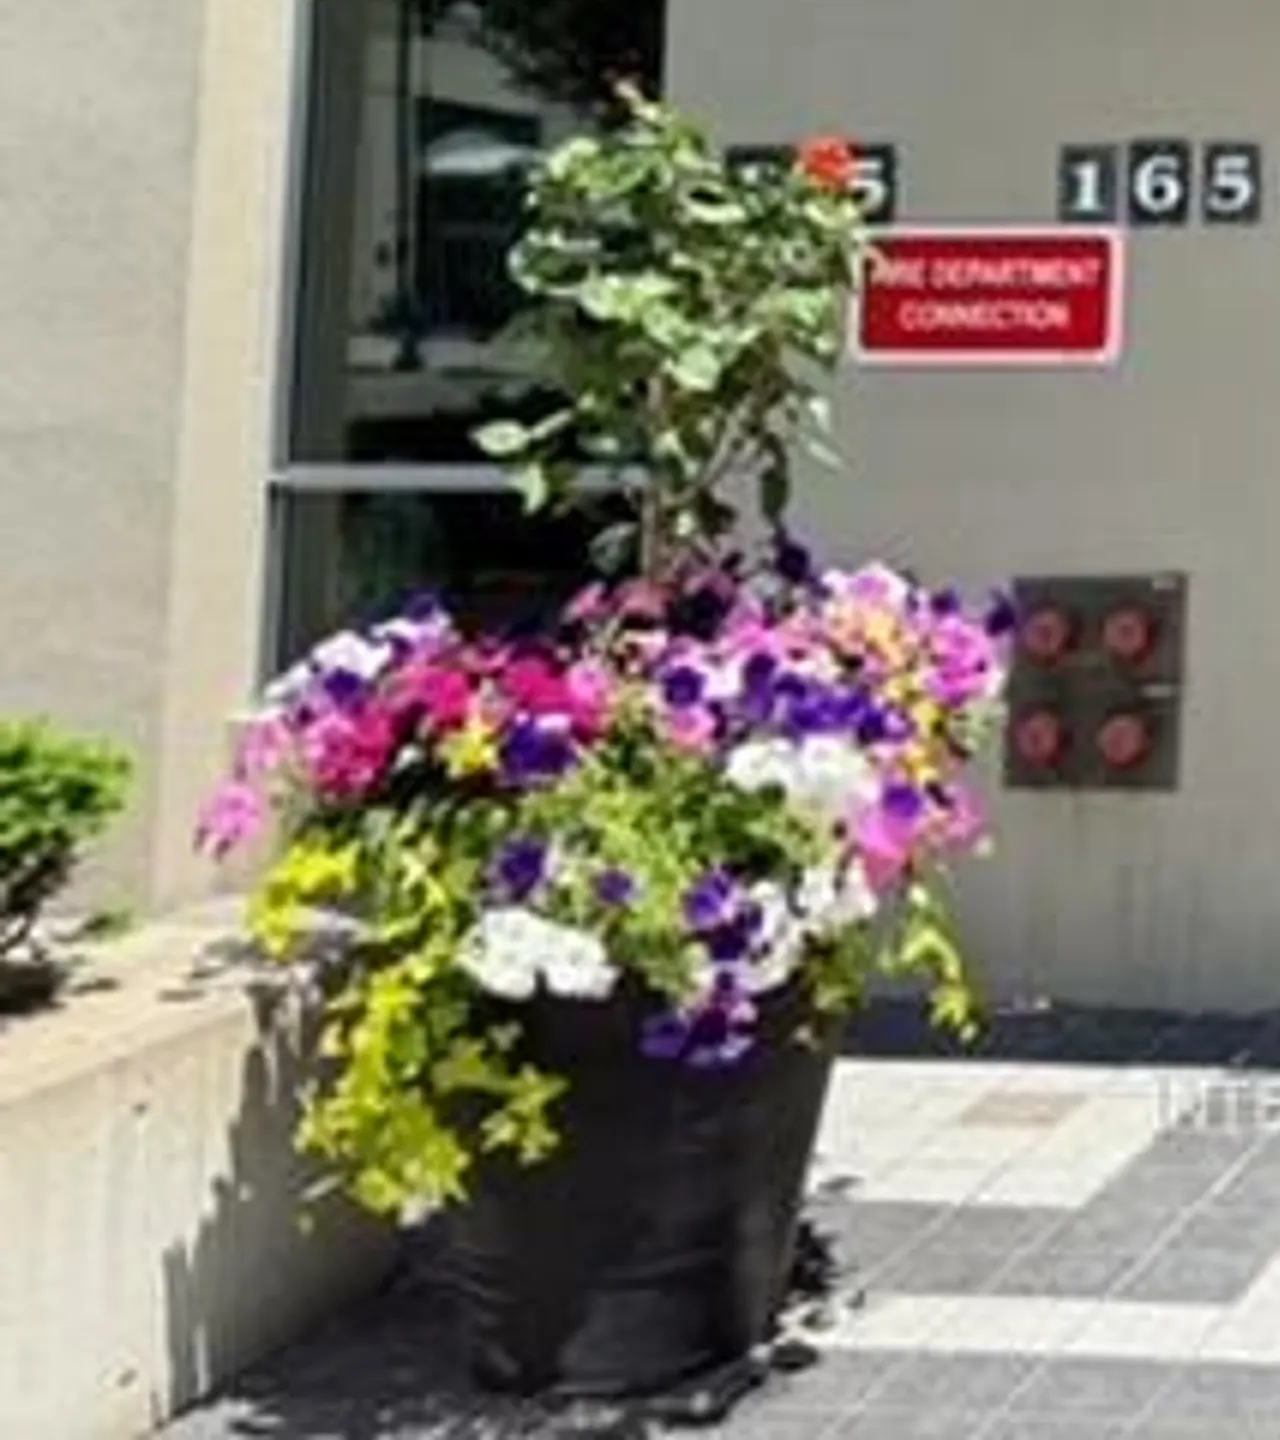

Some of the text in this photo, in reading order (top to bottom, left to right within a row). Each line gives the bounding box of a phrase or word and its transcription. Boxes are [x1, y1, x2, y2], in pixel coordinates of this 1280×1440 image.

[1072, 157, 1255, 213] 165
[931, 258, 1099, 286] DEPARTMENT
[900, 301, 1068, 331] CONNECTION
